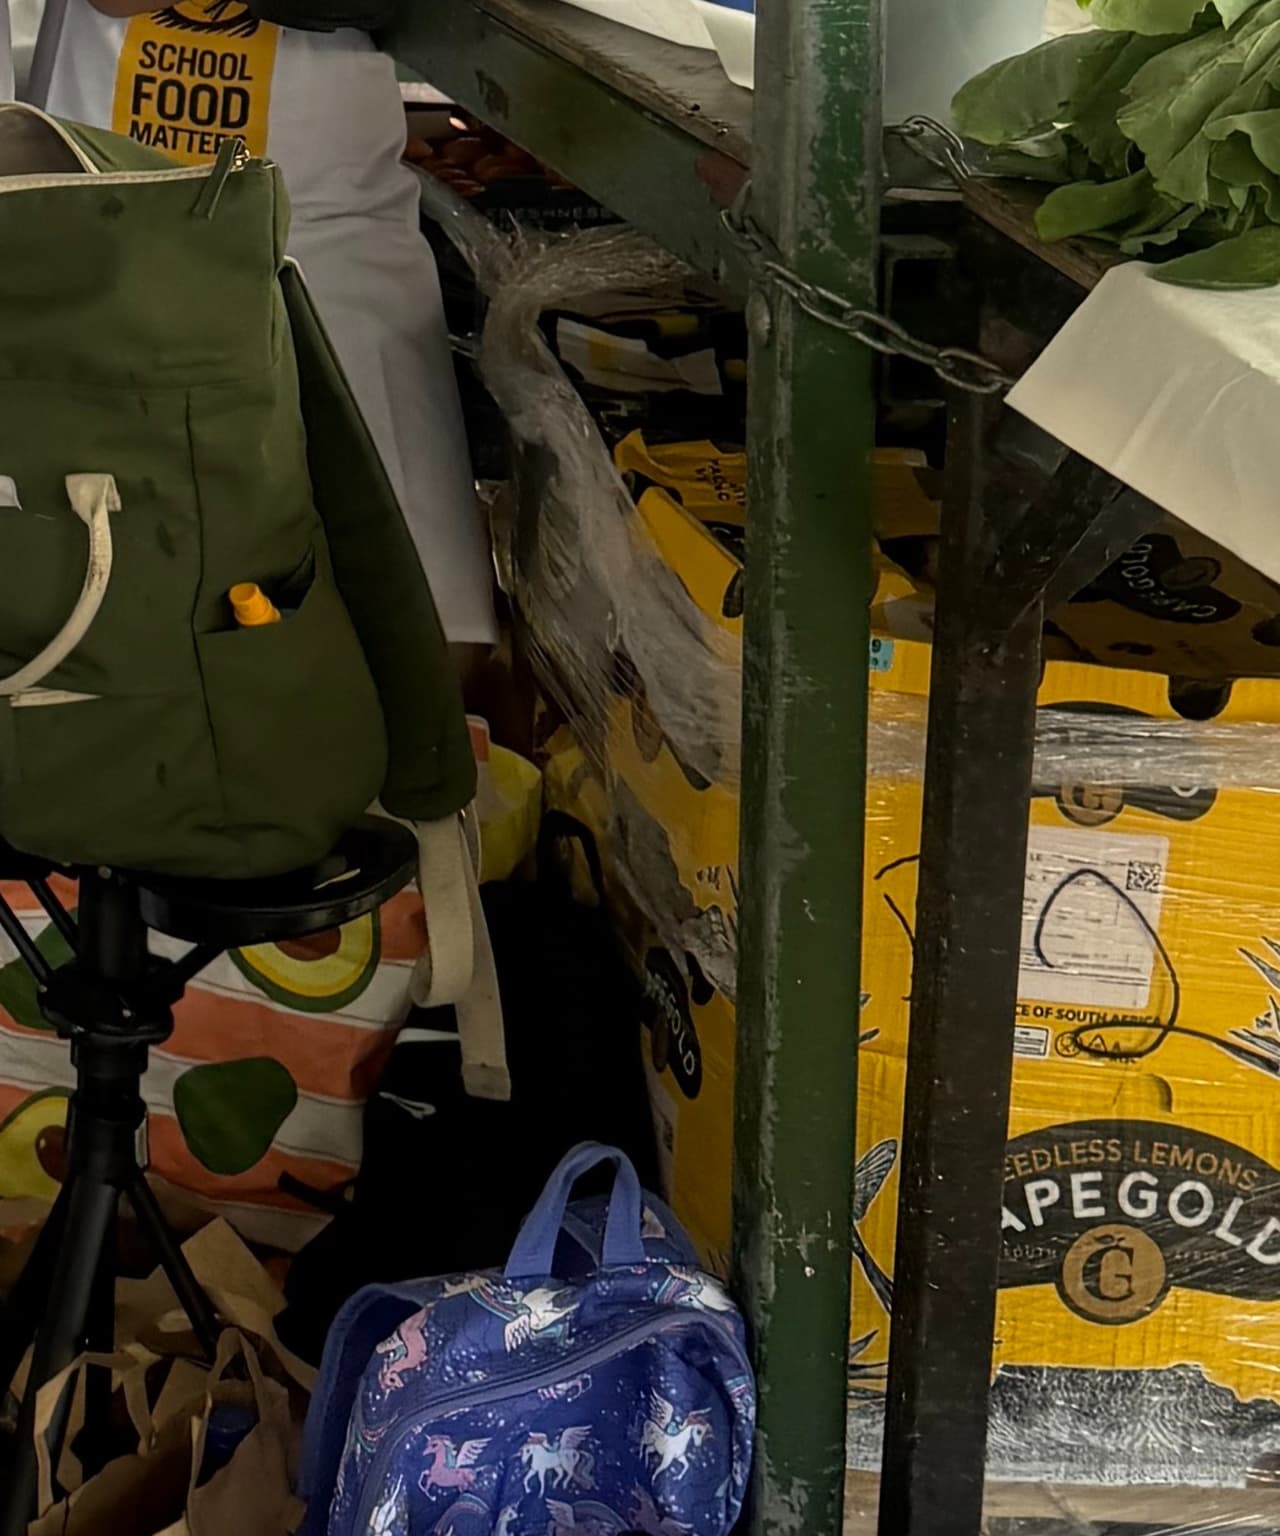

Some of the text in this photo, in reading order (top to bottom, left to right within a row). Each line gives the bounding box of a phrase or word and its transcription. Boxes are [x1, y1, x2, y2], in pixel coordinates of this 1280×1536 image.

[138, 40, 253, 81] SCHOOL
[131, 73, 250, 129] FOOD
[1033, 1005, 1054, 1017] OF
[1133, 1139, 1259, 1192] LEMONS
